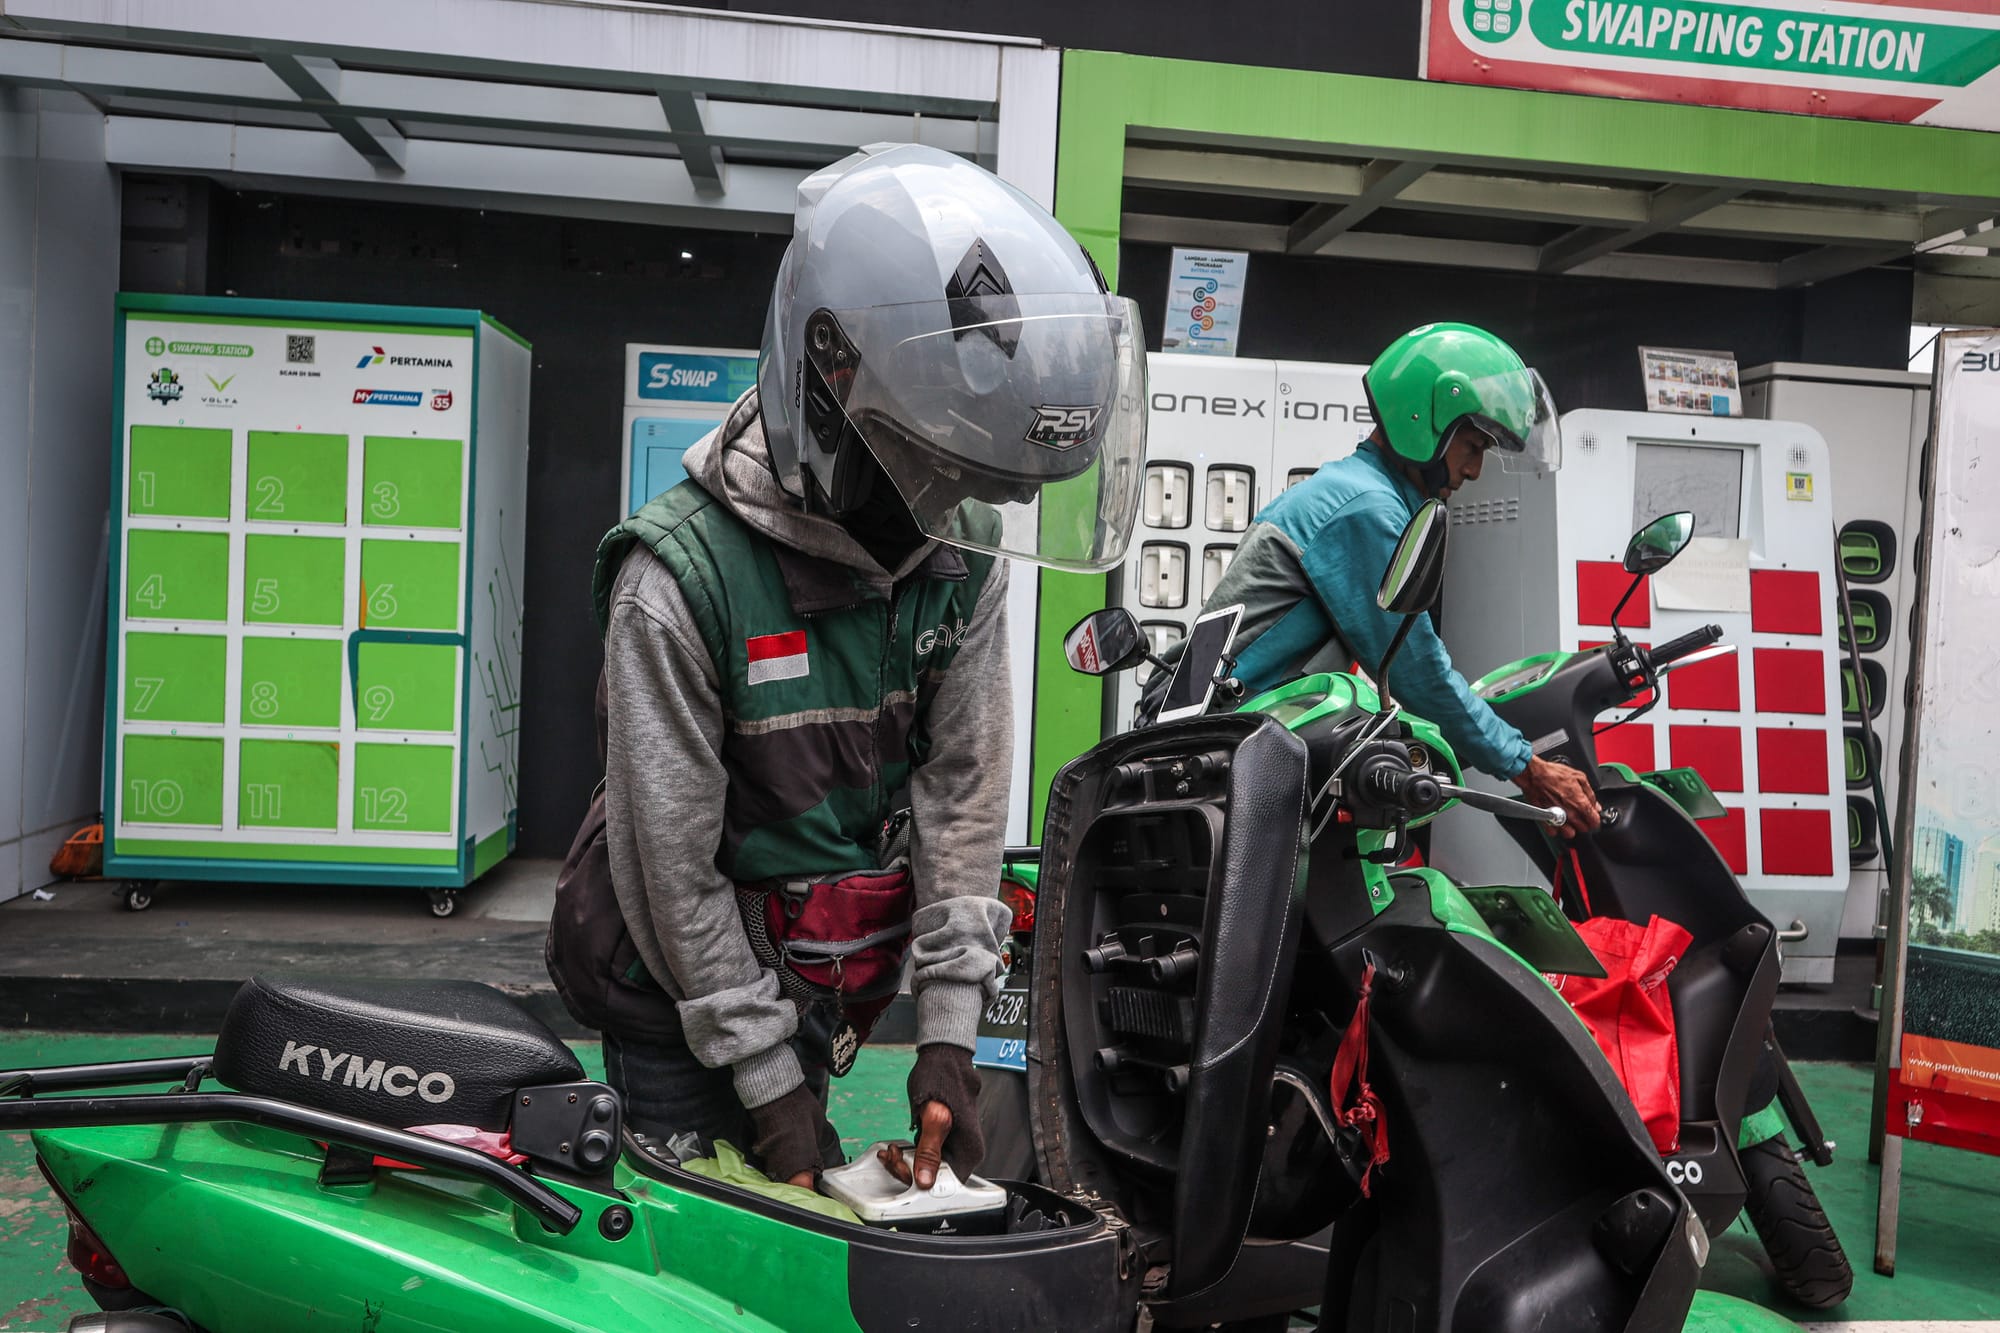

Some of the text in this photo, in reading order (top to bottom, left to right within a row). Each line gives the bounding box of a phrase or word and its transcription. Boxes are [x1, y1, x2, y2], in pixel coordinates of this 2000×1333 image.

[1562, 0, 1925, 73] SWAPPING STATION
[172, 343, 249, 356] SWAPPING STATION
[390, 356, 453, 369] PERTAMINA
[151, 382, 180, 394] SGB
[670, 368, 718, 387] SWAP
[201, 396, 238, 404] VOLTA
[1283, 400, 1376, 424] ione
[1035, 407, 1103, 433] RSV
[1035, 431, 1094, 440] HELMET
[139, 472, 155, 507] 1
[255, 476, 284, 513] 2
[371, 481, 400, 518] 3
[136, 575, 166, 609] 4
[251, 579, 280, 615] 5
[367, 584, 397, 620] 6
[134, 678, 164, 712] 7
[250, 681, 279, 718] 8
[364, 685, 394, 721] 9
[131, 780, 184, 816] 10
[247, 784, 281, 819] 11
[361, 788, 407, 823] 12
[278, 1040, 456, 1104] KYMCO
